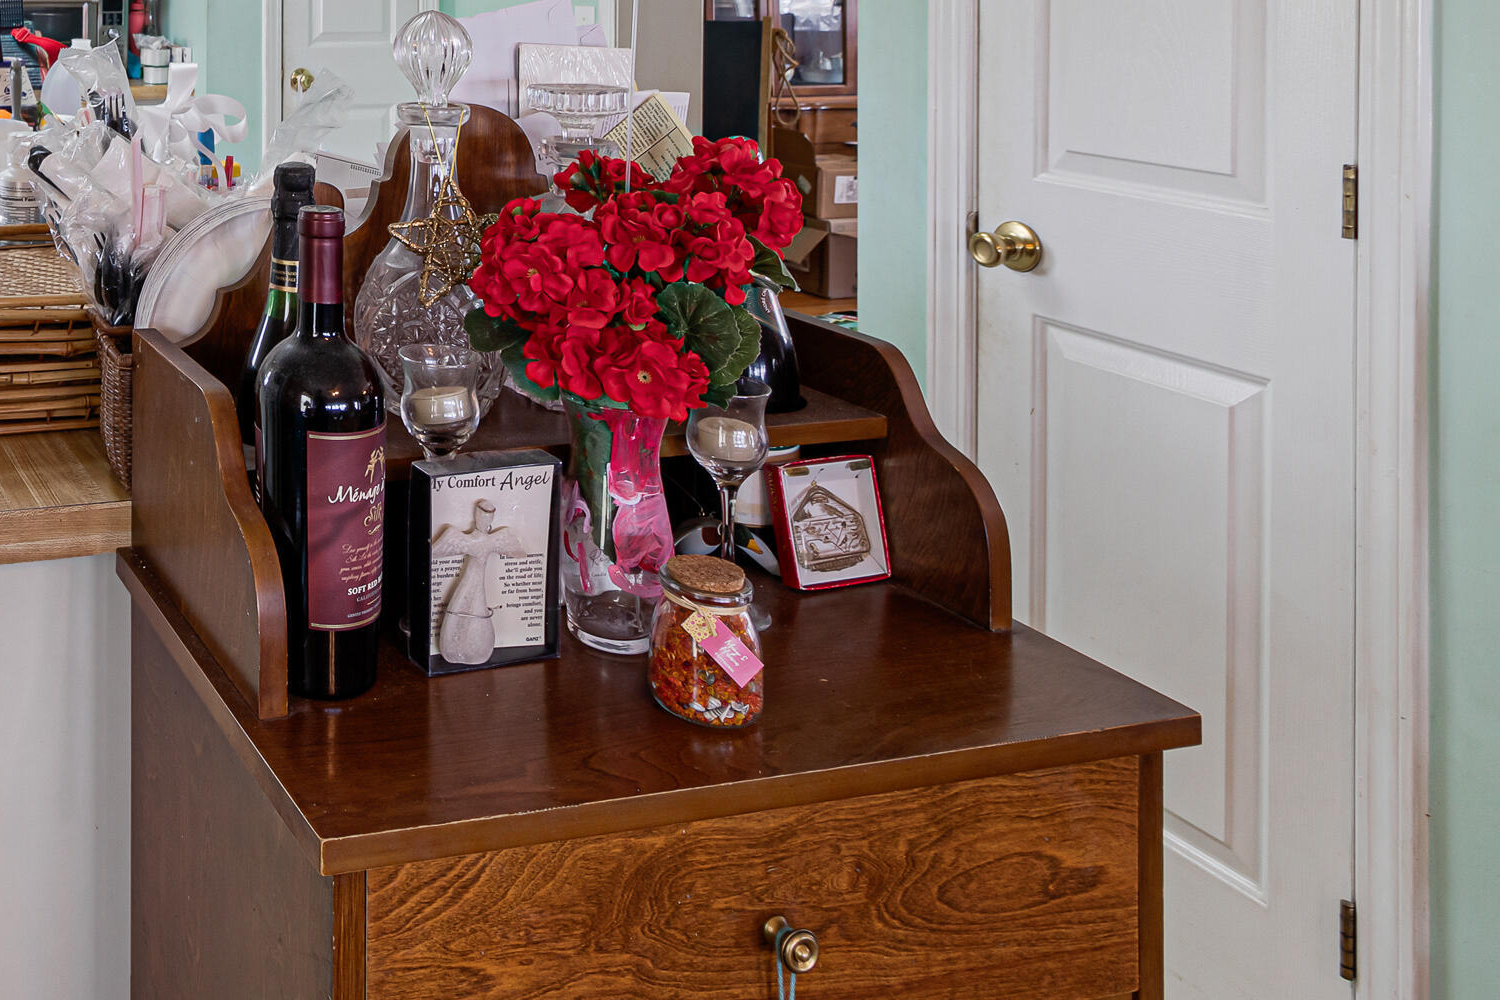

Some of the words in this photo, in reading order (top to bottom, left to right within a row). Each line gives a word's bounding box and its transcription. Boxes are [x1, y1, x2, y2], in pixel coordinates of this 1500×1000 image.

[447, 475, 496, 490] Comfort
[499, 470, 551, 491] Angel
[451, 557, 465, 565] angel
[347, 584, 367, 596] SOFT
[367, 579, 378, 591] RED
